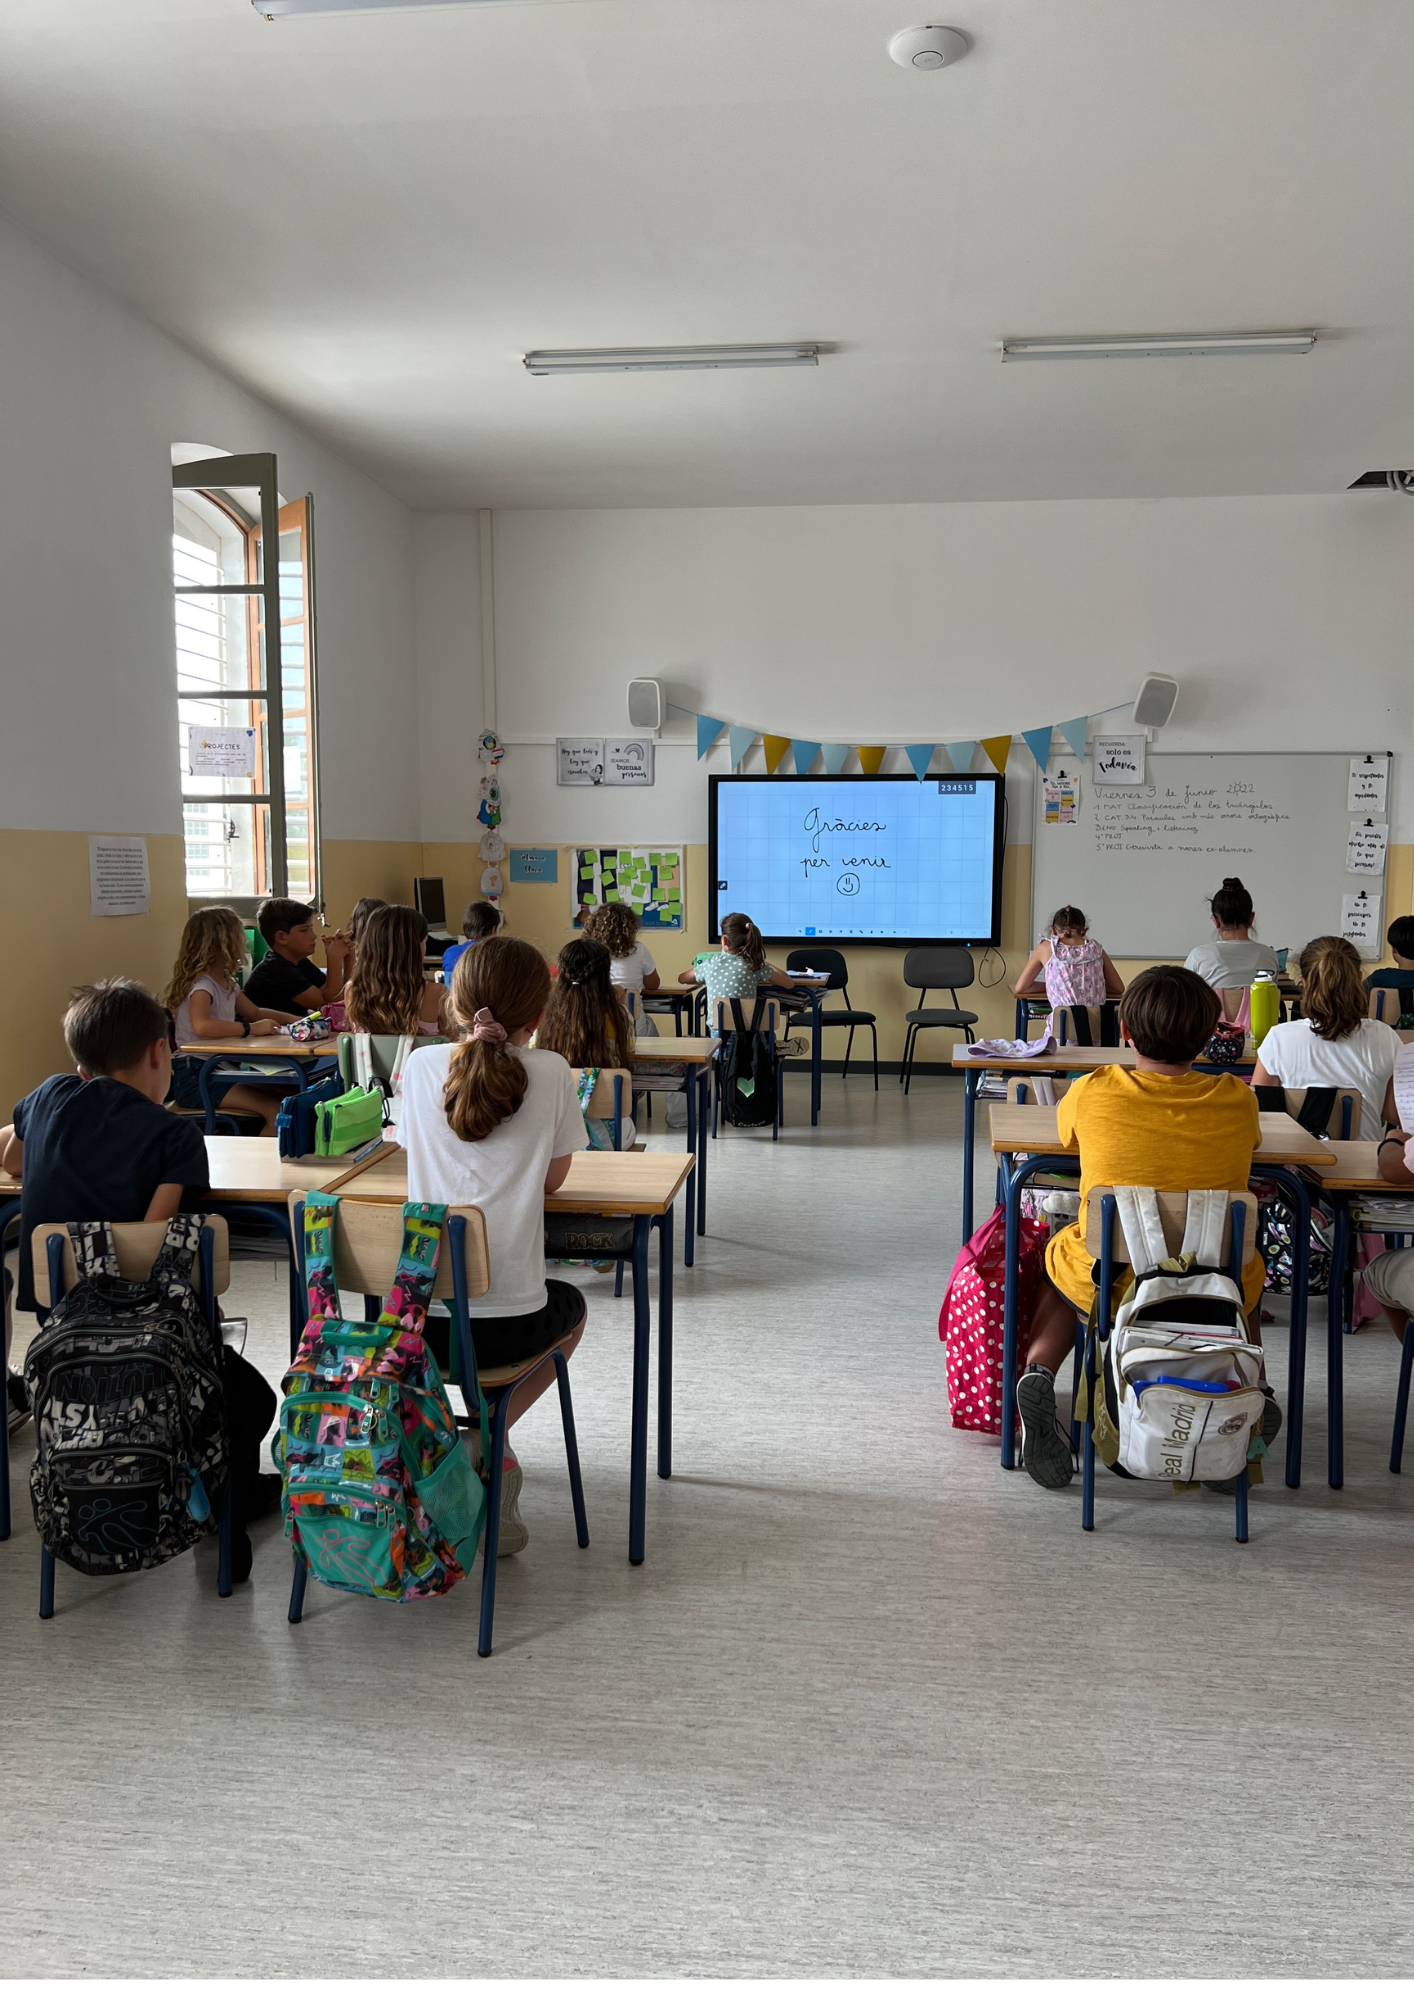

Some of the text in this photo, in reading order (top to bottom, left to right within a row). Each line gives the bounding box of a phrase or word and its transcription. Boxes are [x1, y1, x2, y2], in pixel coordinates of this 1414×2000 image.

[622, 772, 647, 780] personas
[1094, 788, 1144, 799] Viernes
[1146, 785, 1157, 798] 3
[1165, 788, 1177, 798] de
[1184, 785, 1218, 804] junio
[1127, 803, 1187, 814] Clasificación
[1193, 801, 1202, 809] de
[1208, 801, 1221, 810] los
[1226, 801, 1273, 813] triángulos
[1141, 813, 1176, 821] Paraules
[1181, 812, 1197, 820] amb
[804, 807, 887, 853] Gràcies
[1120, 824, 1154, 836] Speaking
[1125, 843, 1163, 851] Entrevista
[800, 856, 892, 878] per venir
[565, 1233, 615, 1249] ROCK
